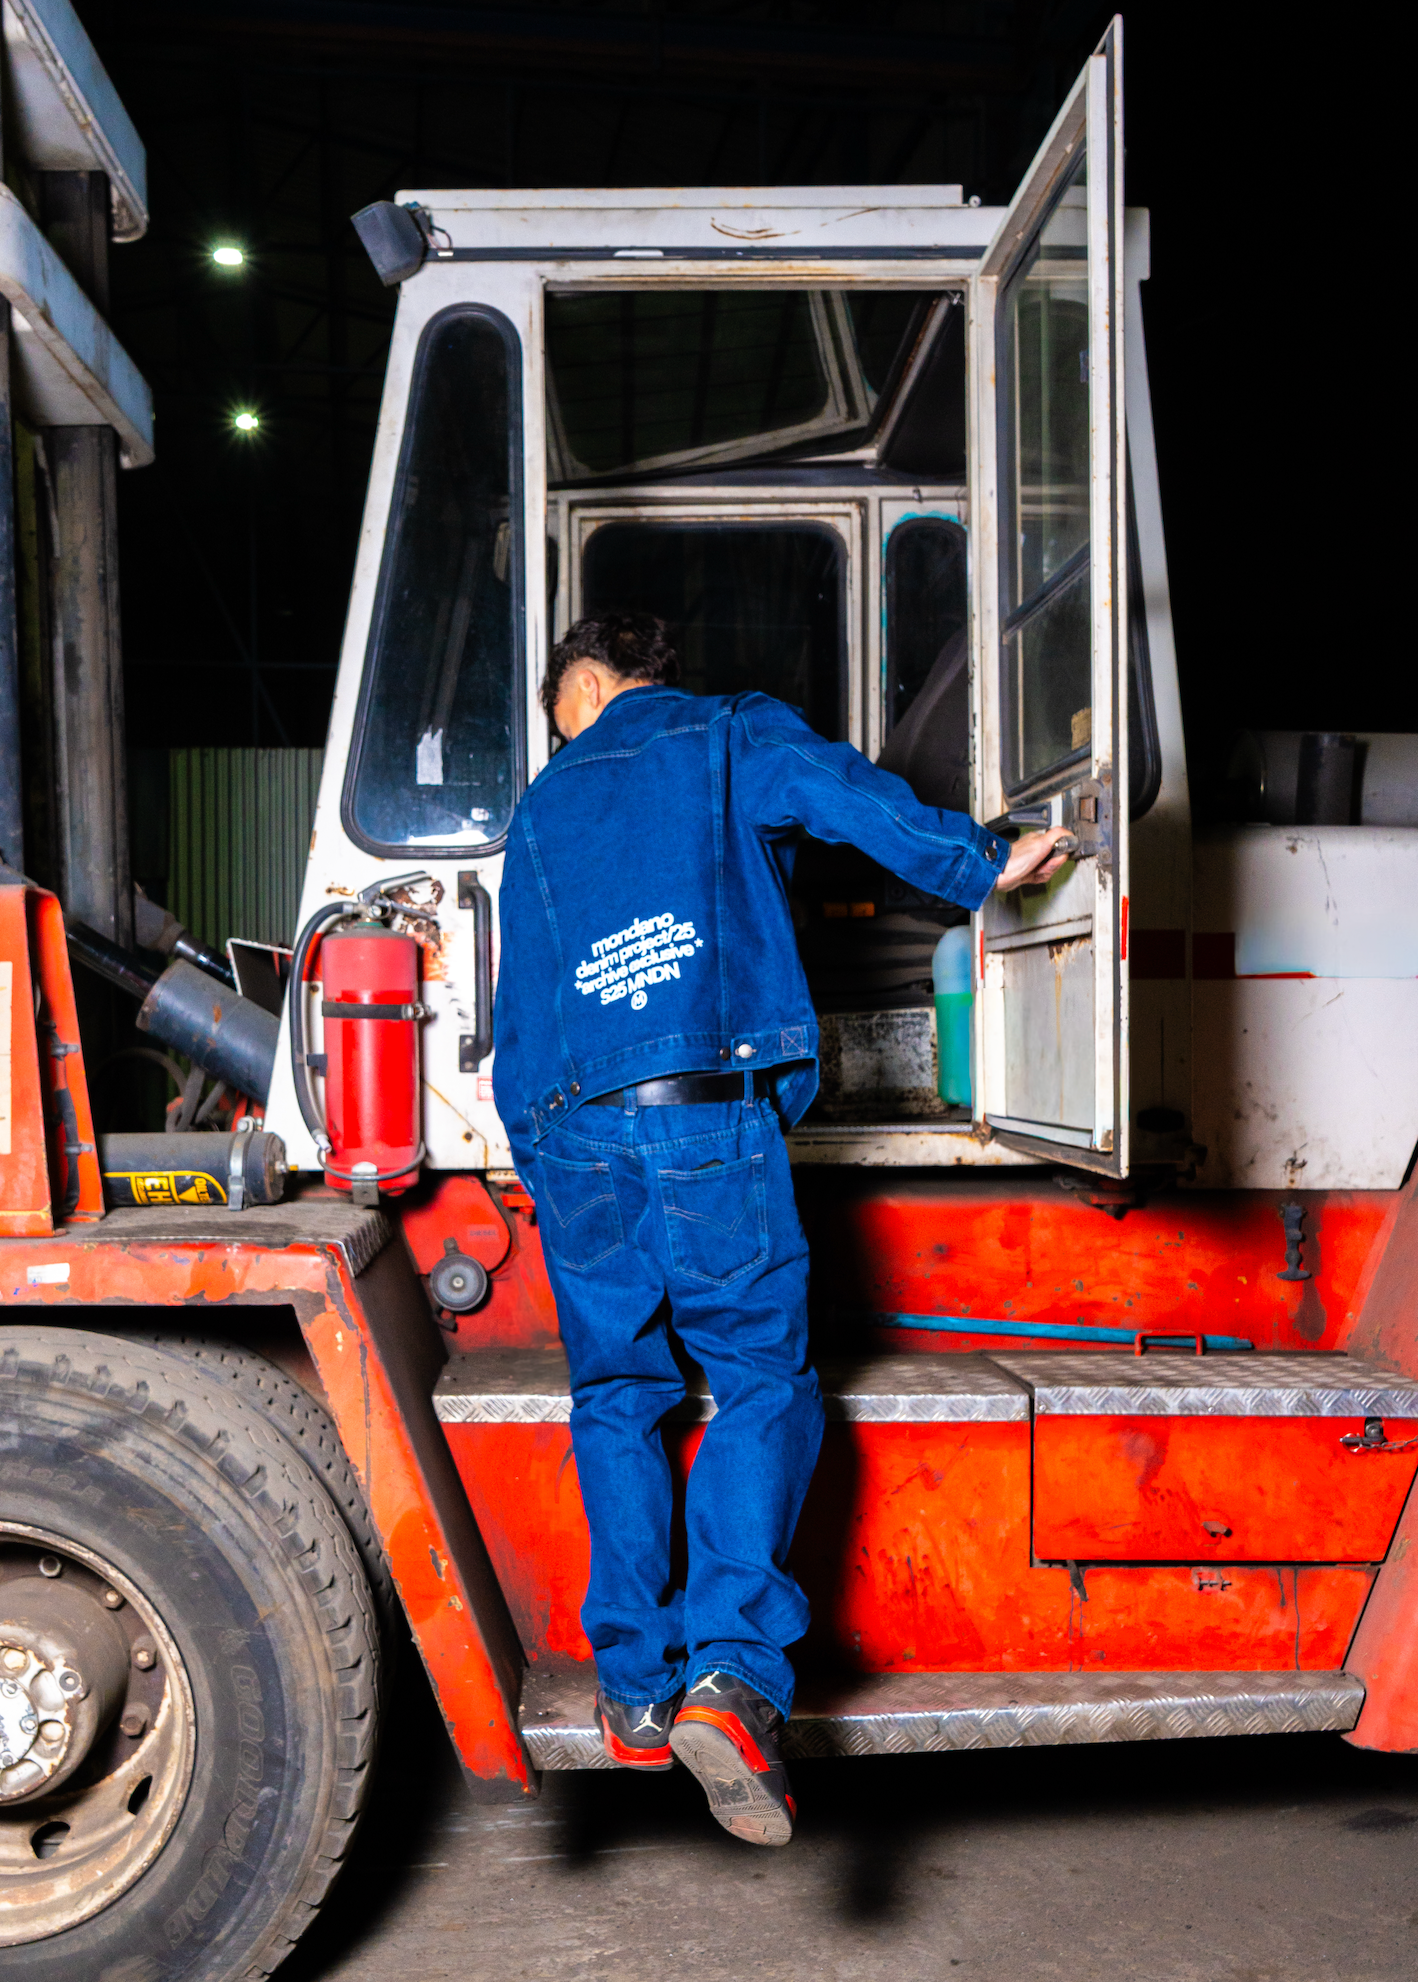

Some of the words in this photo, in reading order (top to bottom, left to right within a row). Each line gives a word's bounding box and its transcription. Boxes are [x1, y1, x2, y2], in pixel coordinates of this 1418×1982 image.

[575, 953, 619, 979] denim
[619, 921, 696, 966] project/25
[591, 912, 675, 957] mondano
[600, 980, 628, 1005] S25
[627, 961, 681, 994] MNDN
[164, 1664, 266, 1950] GOODRIDE
